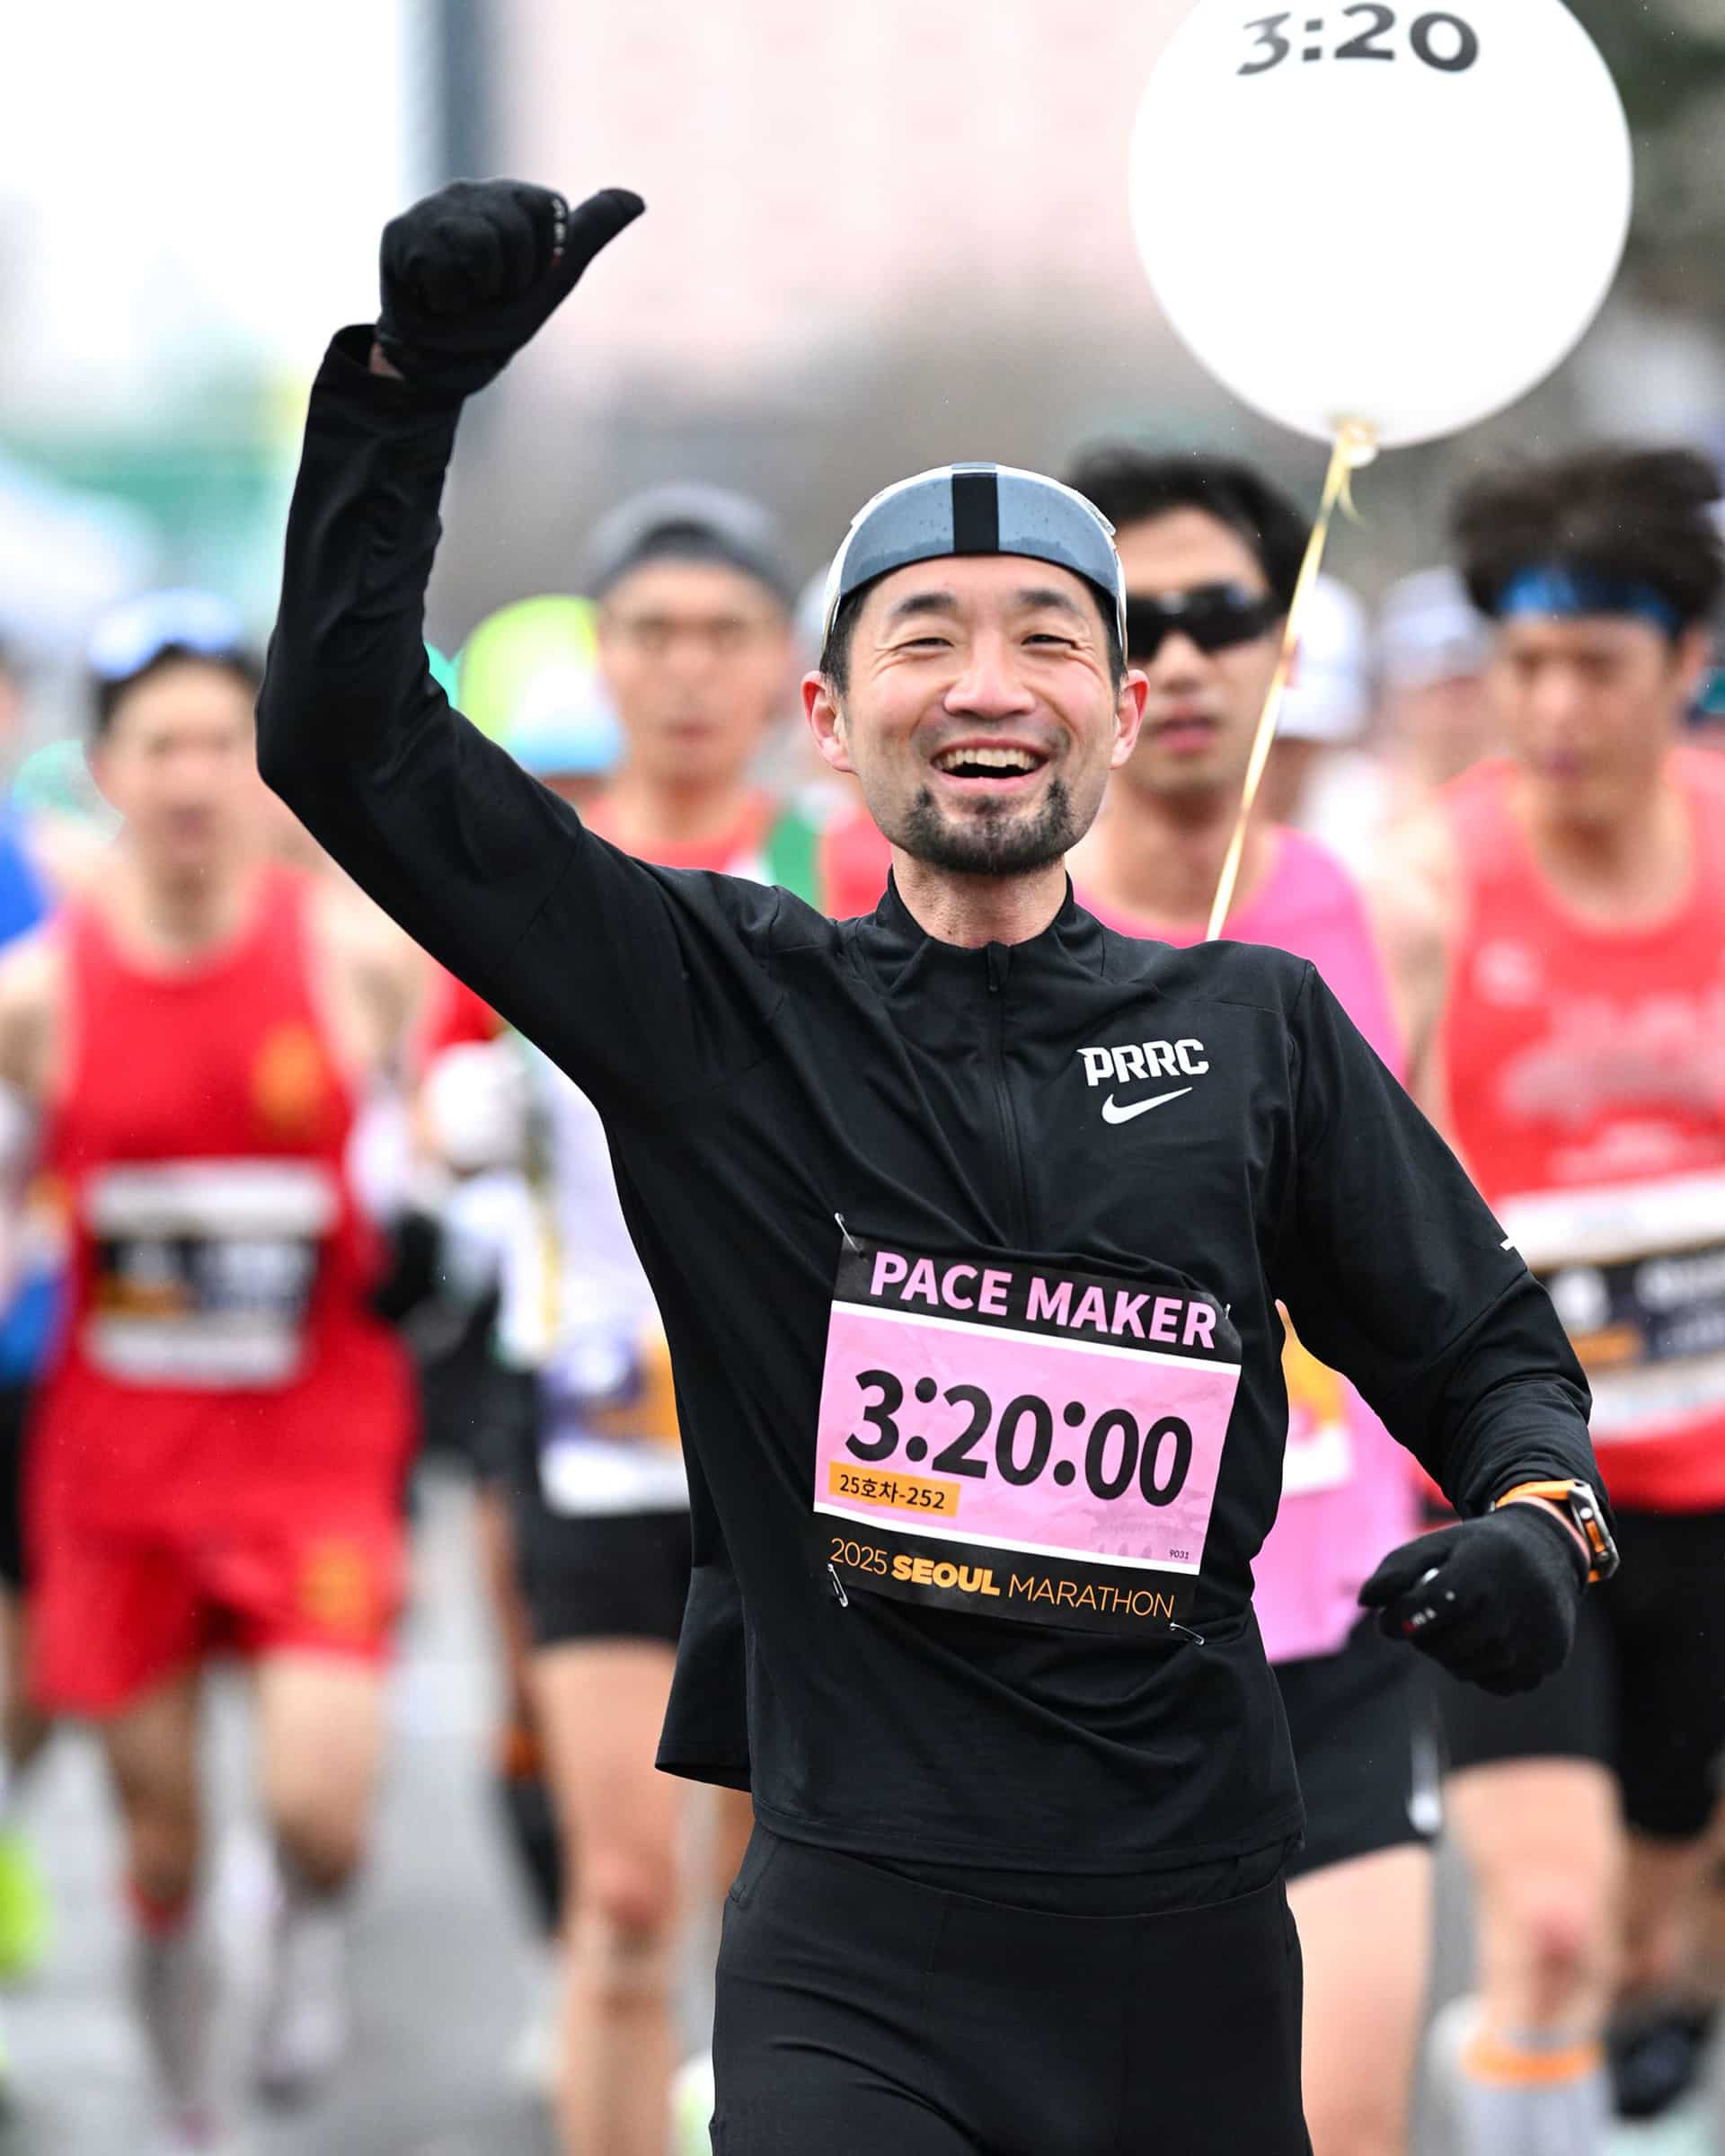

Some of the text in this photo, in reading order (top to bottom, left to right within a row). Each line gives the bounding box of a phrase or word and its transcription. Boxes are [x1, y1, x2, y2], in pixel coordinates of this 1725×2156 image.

[1236, 3, 1479, 75] 3:20
[1076, 1038, 1209, 1086] PRRC
[870, 1250, 1217, 1348] PACE MAKER
[845, 1369, 1192, 1507] 3:20:00
[839, 1474, 945, 1510] 25호차-252
[830, 1537, 1175, 1618] 2025 SEOUL MARATHON
